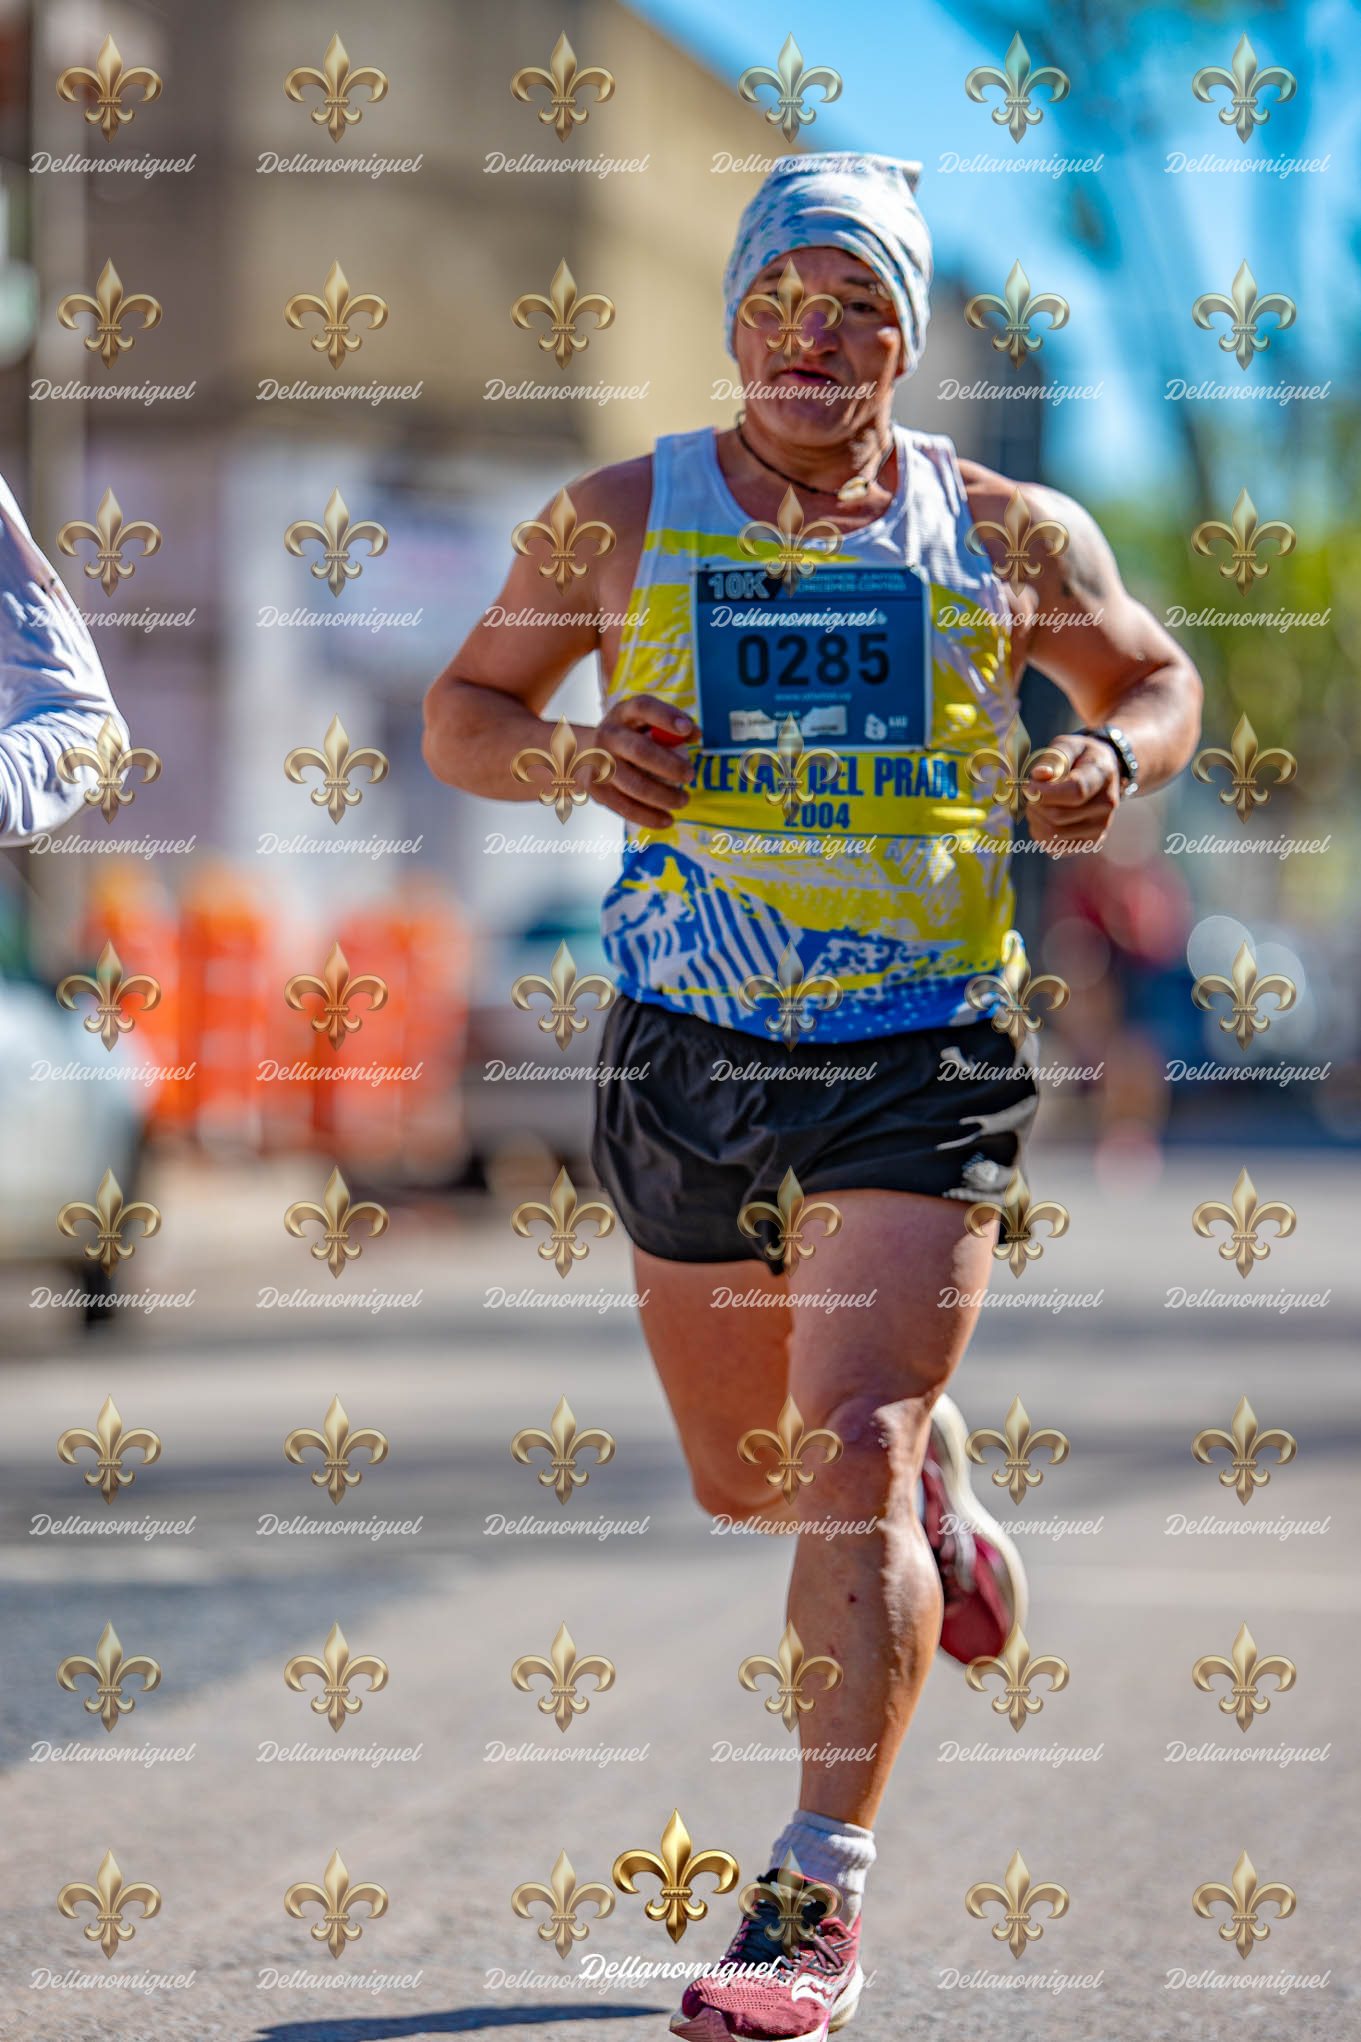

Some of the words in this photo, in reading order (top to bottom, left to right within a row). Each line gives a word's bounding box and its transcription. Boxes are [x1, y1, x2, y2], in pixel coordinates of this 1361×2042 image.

[707, 572, 771, 600] 10K
[737, 633, 890, 688] 0285
[874, 756, 958, 800] PRADO
[783, 802, 850, 829] 2004
